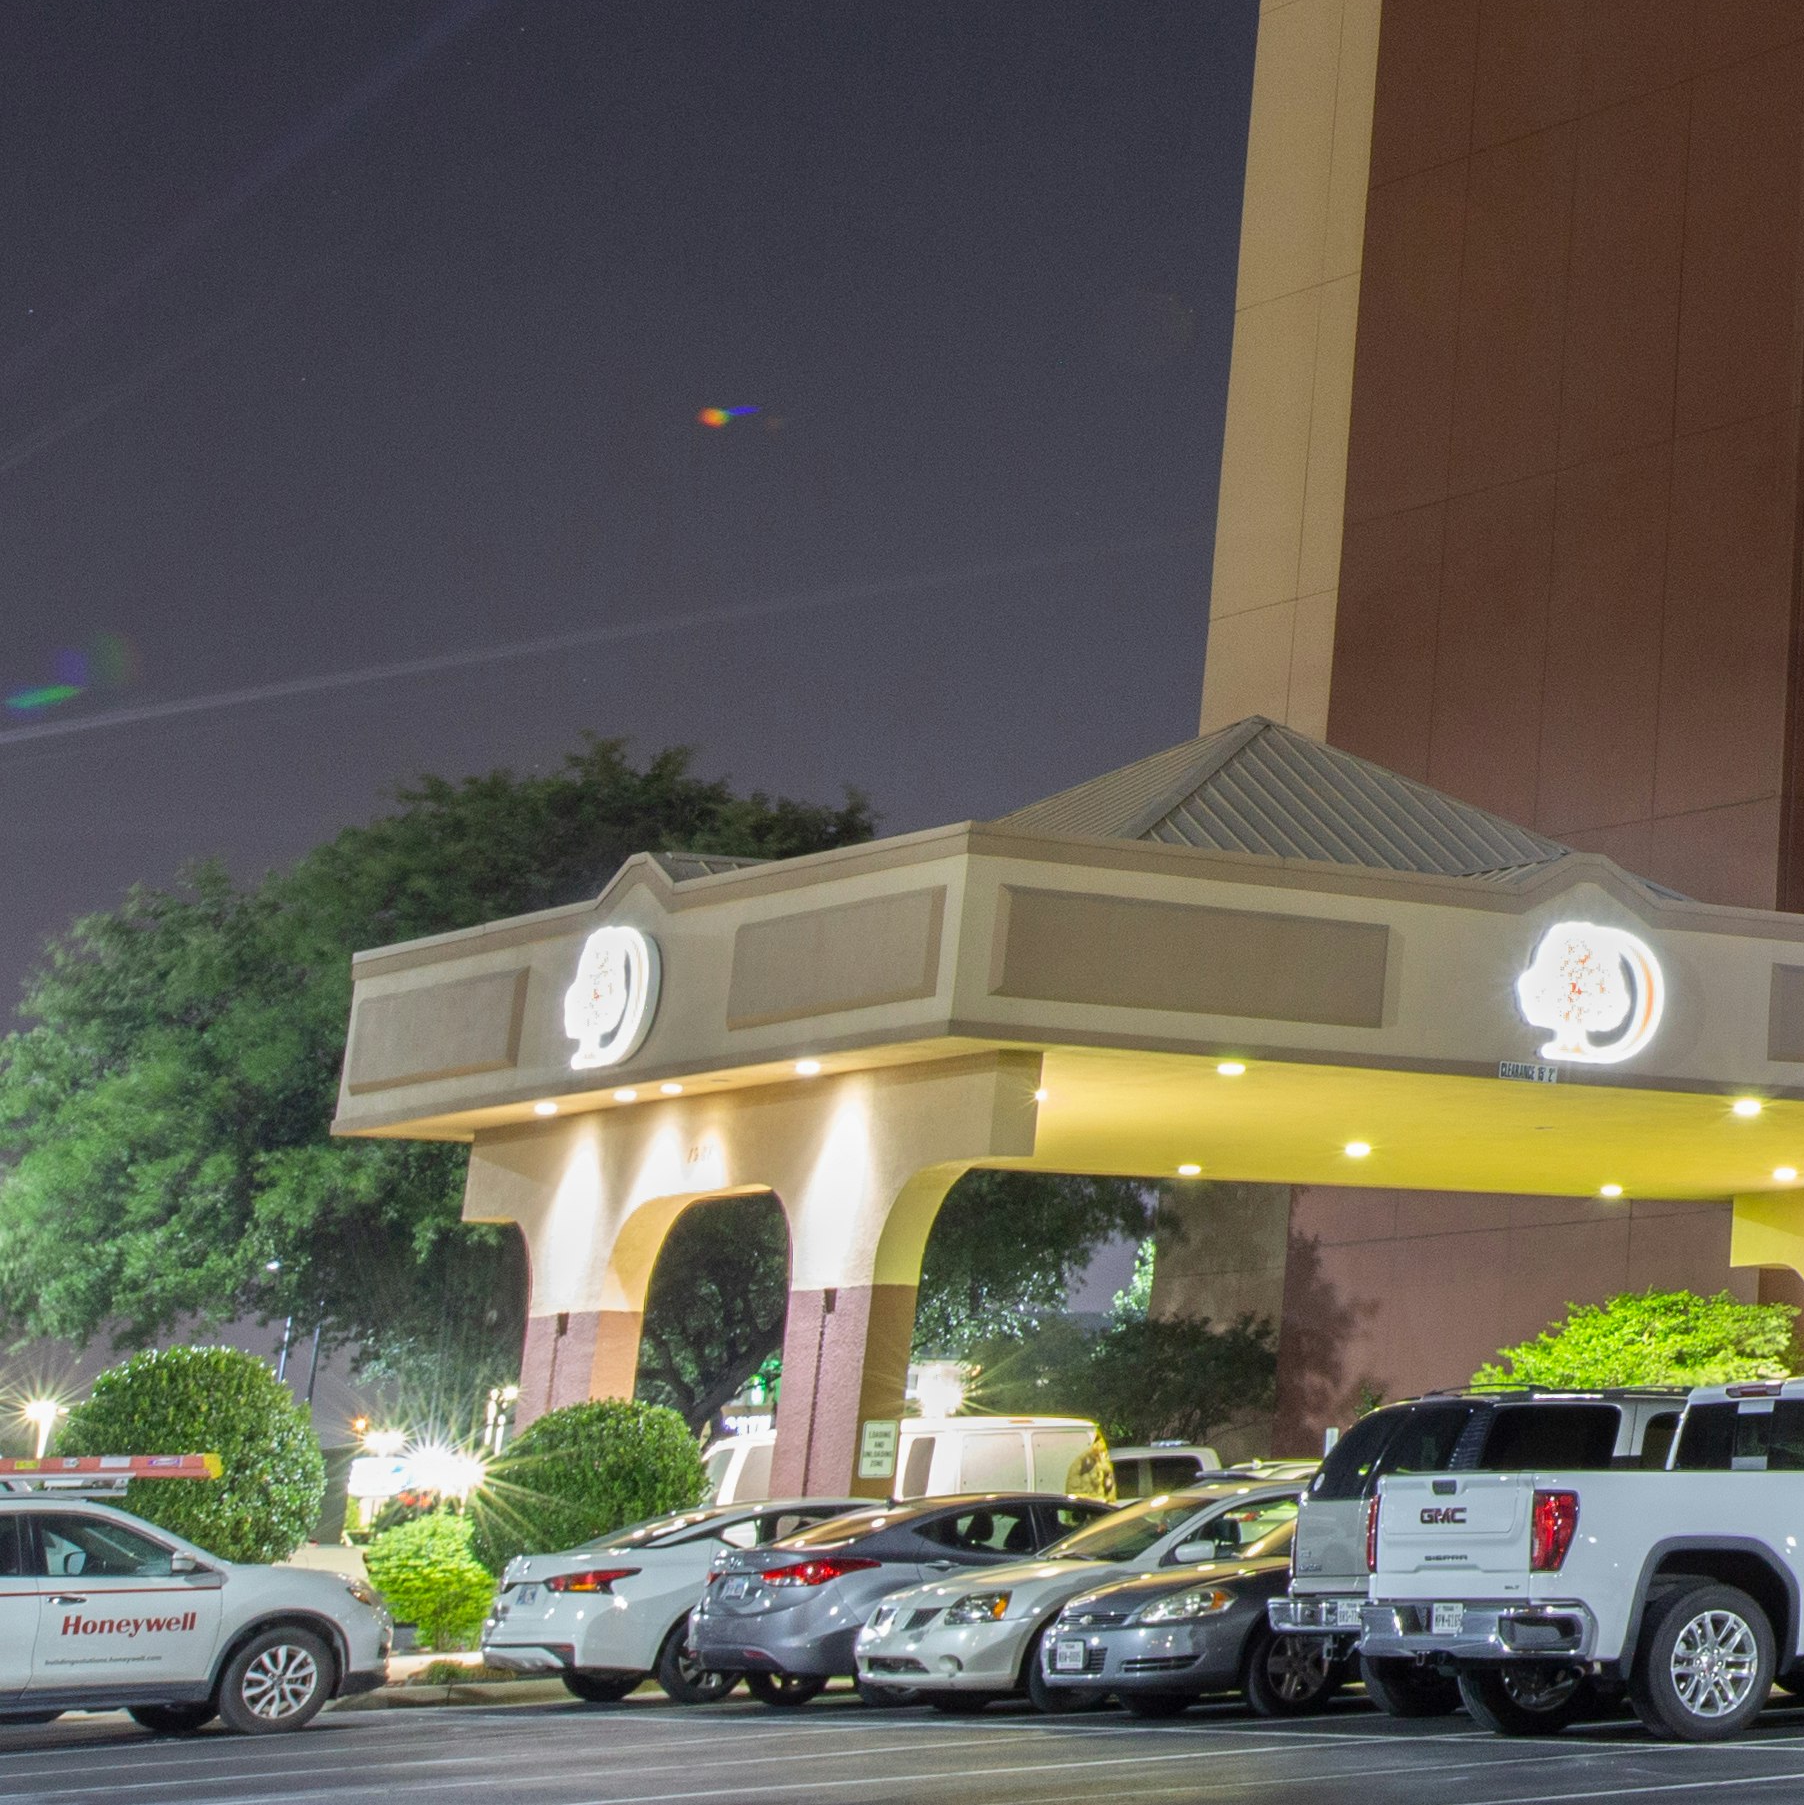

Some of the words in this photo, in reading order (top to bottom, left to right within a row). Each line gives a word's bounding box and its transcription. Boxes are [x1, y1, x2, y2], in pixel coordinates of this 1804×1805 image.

[1501, 1062, 1536, 1081] CLEARANCE
[868, 1430, 892, 1439] LOADING
[1420, 1507, 1467, 1524] GMC
[61, 1611, 197, 1638] Honeywell
